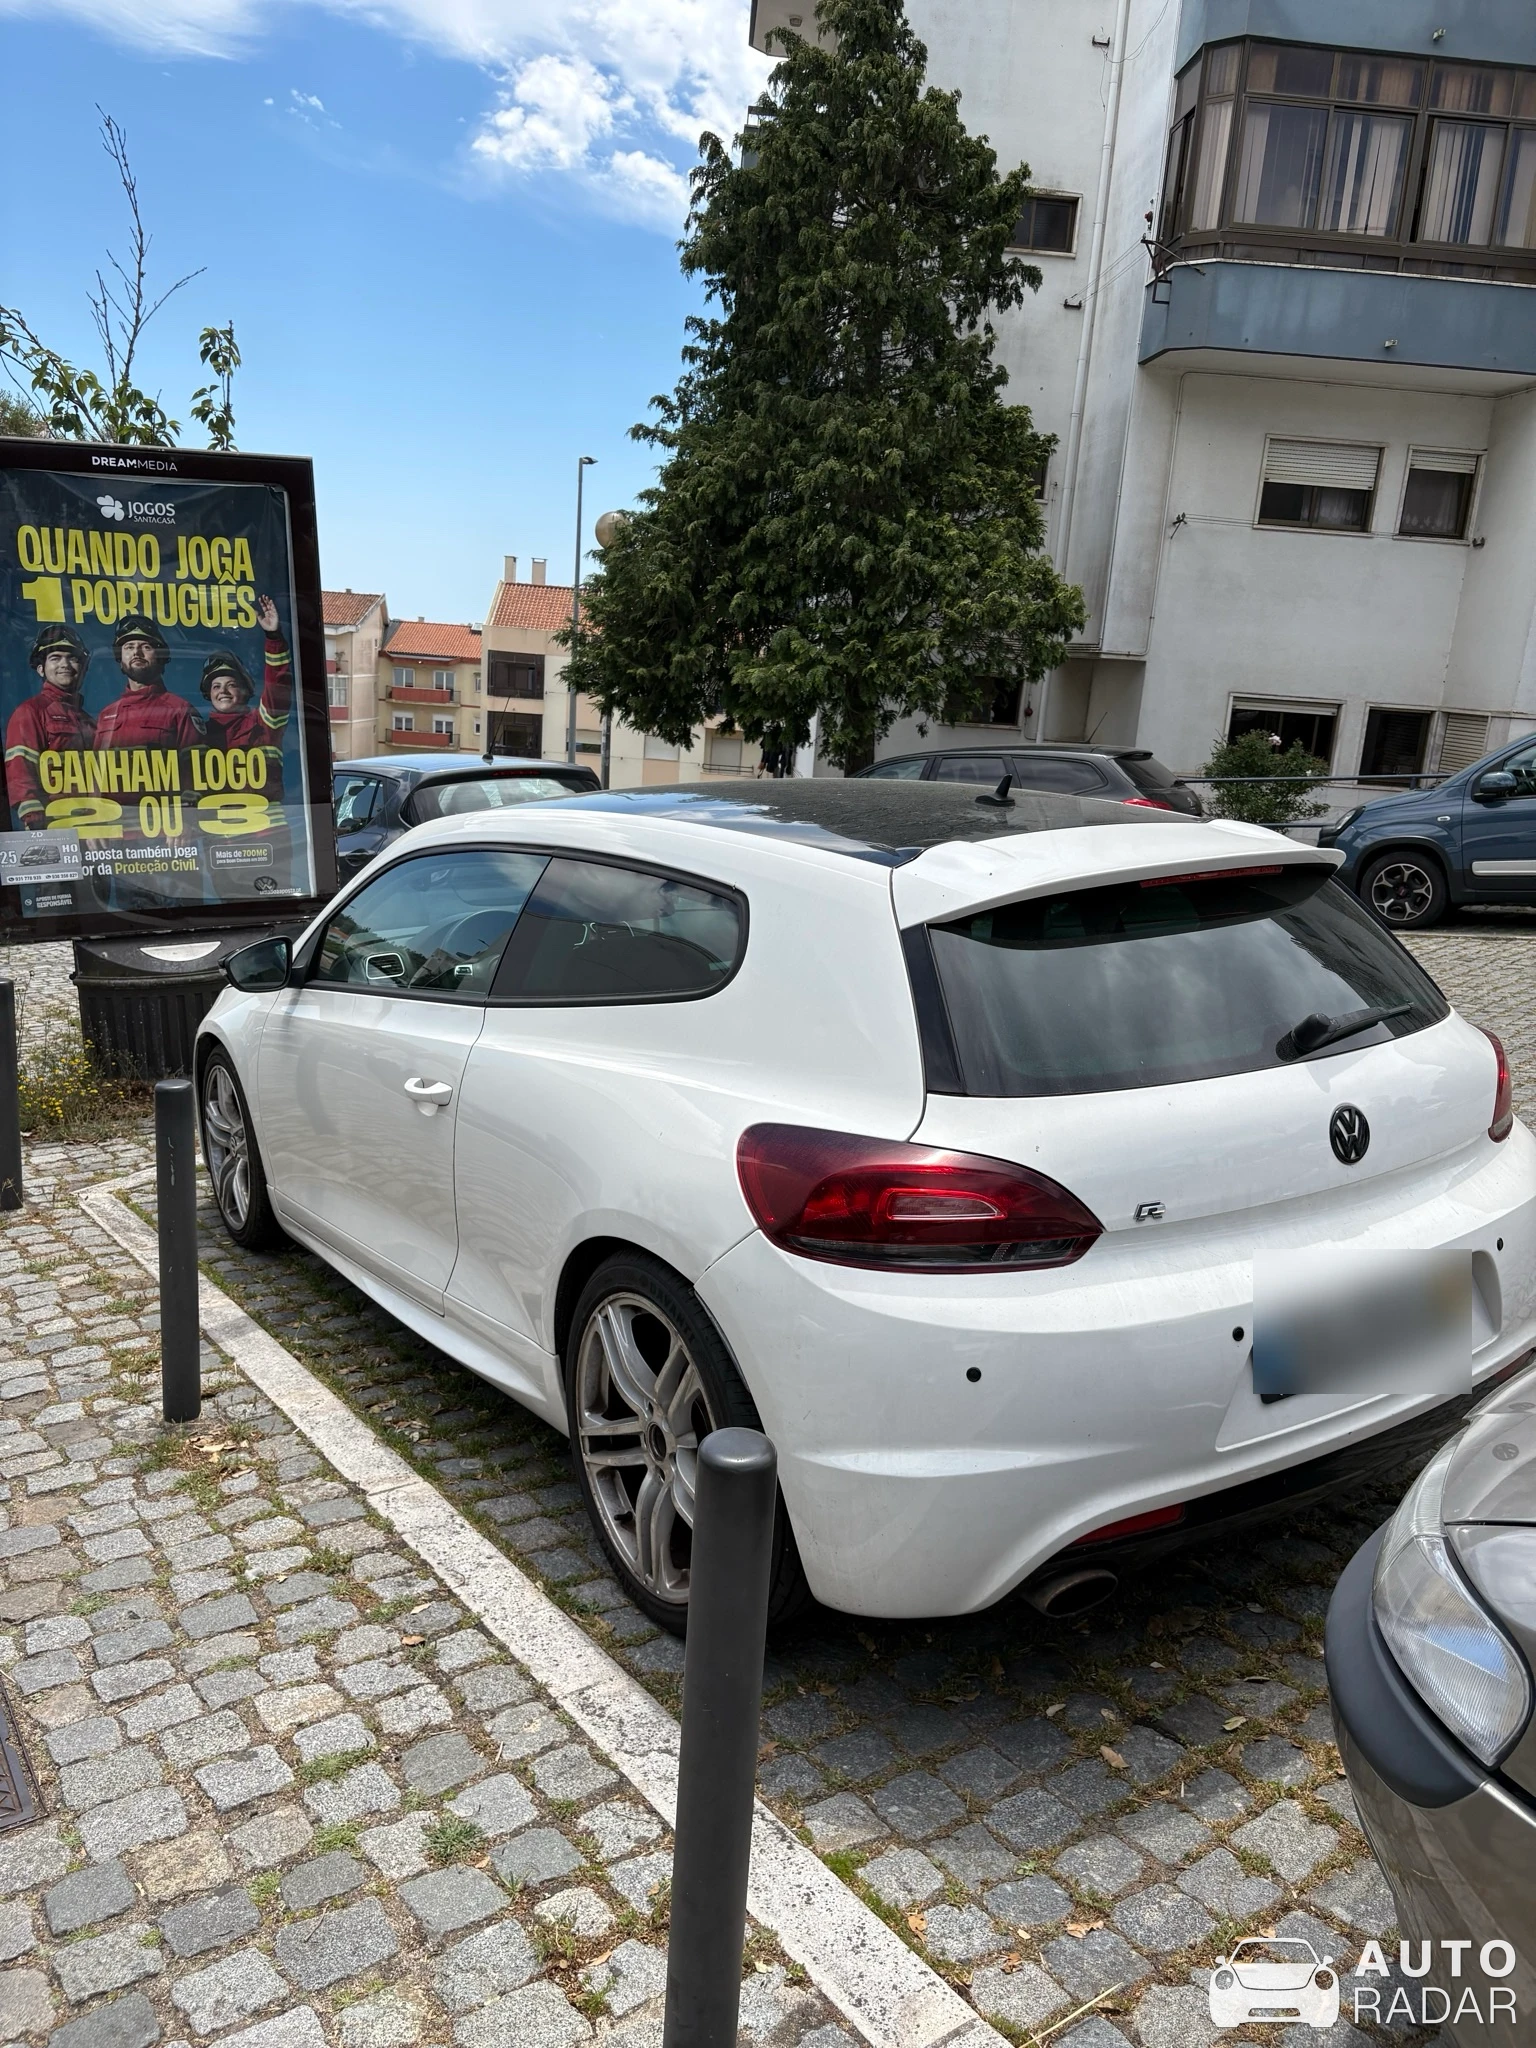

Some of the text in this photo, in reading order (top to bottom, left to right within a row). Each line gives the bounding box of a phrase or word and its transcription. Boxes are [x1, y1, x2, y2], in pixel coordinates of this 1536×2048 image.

[128, 501, 176, 518] JOGOS
[17, 525, 256, 582] QUANDO JOGA
[21, 570, 258, 629] 1 PORTUGUÊS
[39, 748, 267, 794] GANHAM LOGO
[45, 793, 271, 840] 2 OU 3
[0, 850, 17, 864] 25
[85, 845, 198, 862] aposta também joga
[215, 850, 233, 859] Mais
[233, 849, 243, 858] de
[97, 862, 112, 876] da
[114, 859, 169, 875] Proteção
[171, 858, 200, 872] Civil.
